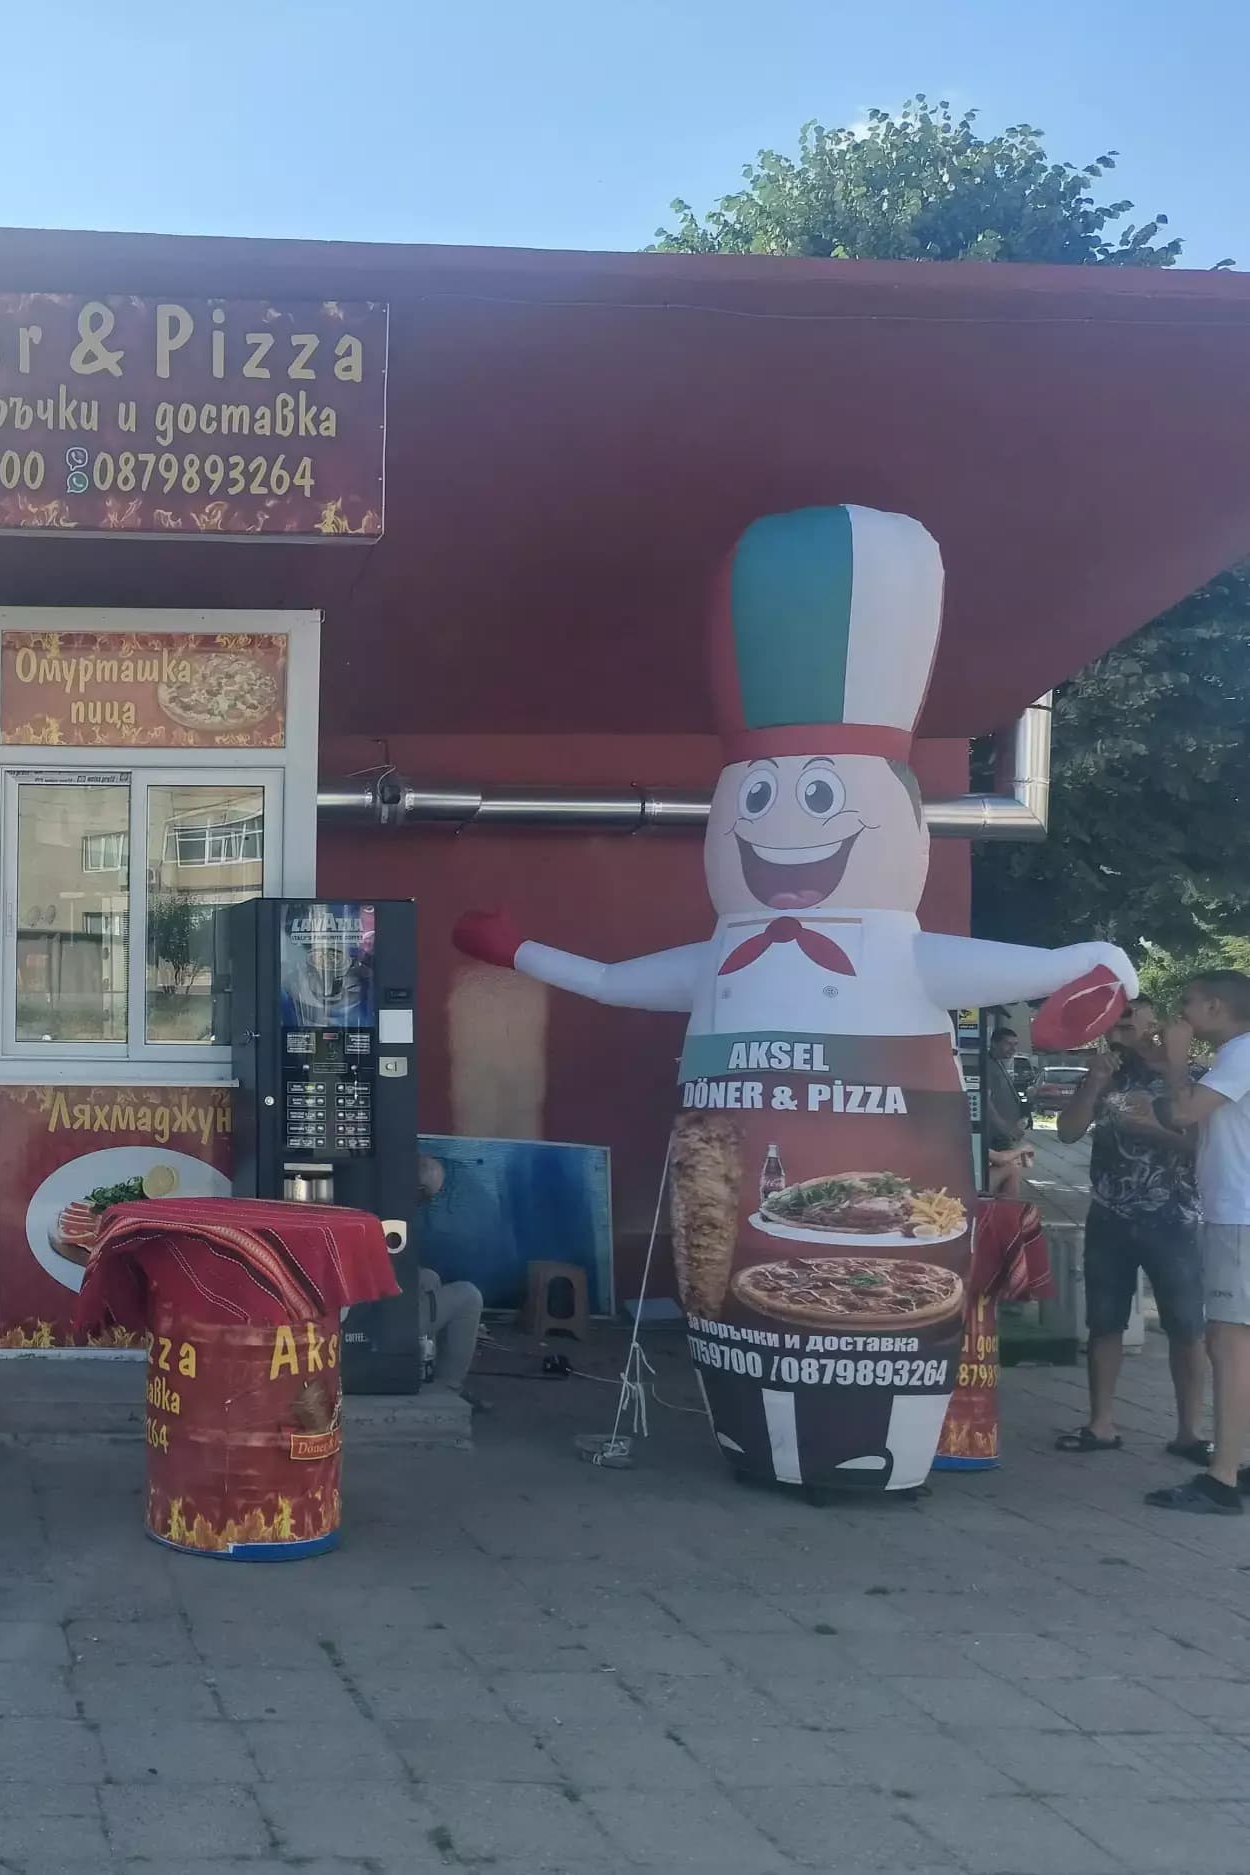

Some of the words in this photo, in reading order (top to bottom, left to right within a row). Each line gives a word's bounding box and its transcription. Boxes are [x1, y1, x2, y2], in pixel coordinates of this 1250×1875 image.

[70, 302, 126, 378] &
[156, 303, 363, 383] Pizza
[118, 401, 136, 432] и
[155, 390, 337, 446] доставка
[93, 451, 315, 497] 0879893264
[15, 647, 192, 694] Омурташка
[70, 700, 136, 728] пица
[727, 1041, 830, 1072] AKSEL
[683, 1077, 763, 1109] DÖNER
[771, 1086, 798, 1111] &
[48, 1091, 232, 1145] Ляхмаджун
[700, 1318, 780, 1348] поръчки
[805, 1335, 919, 1352] доставка
